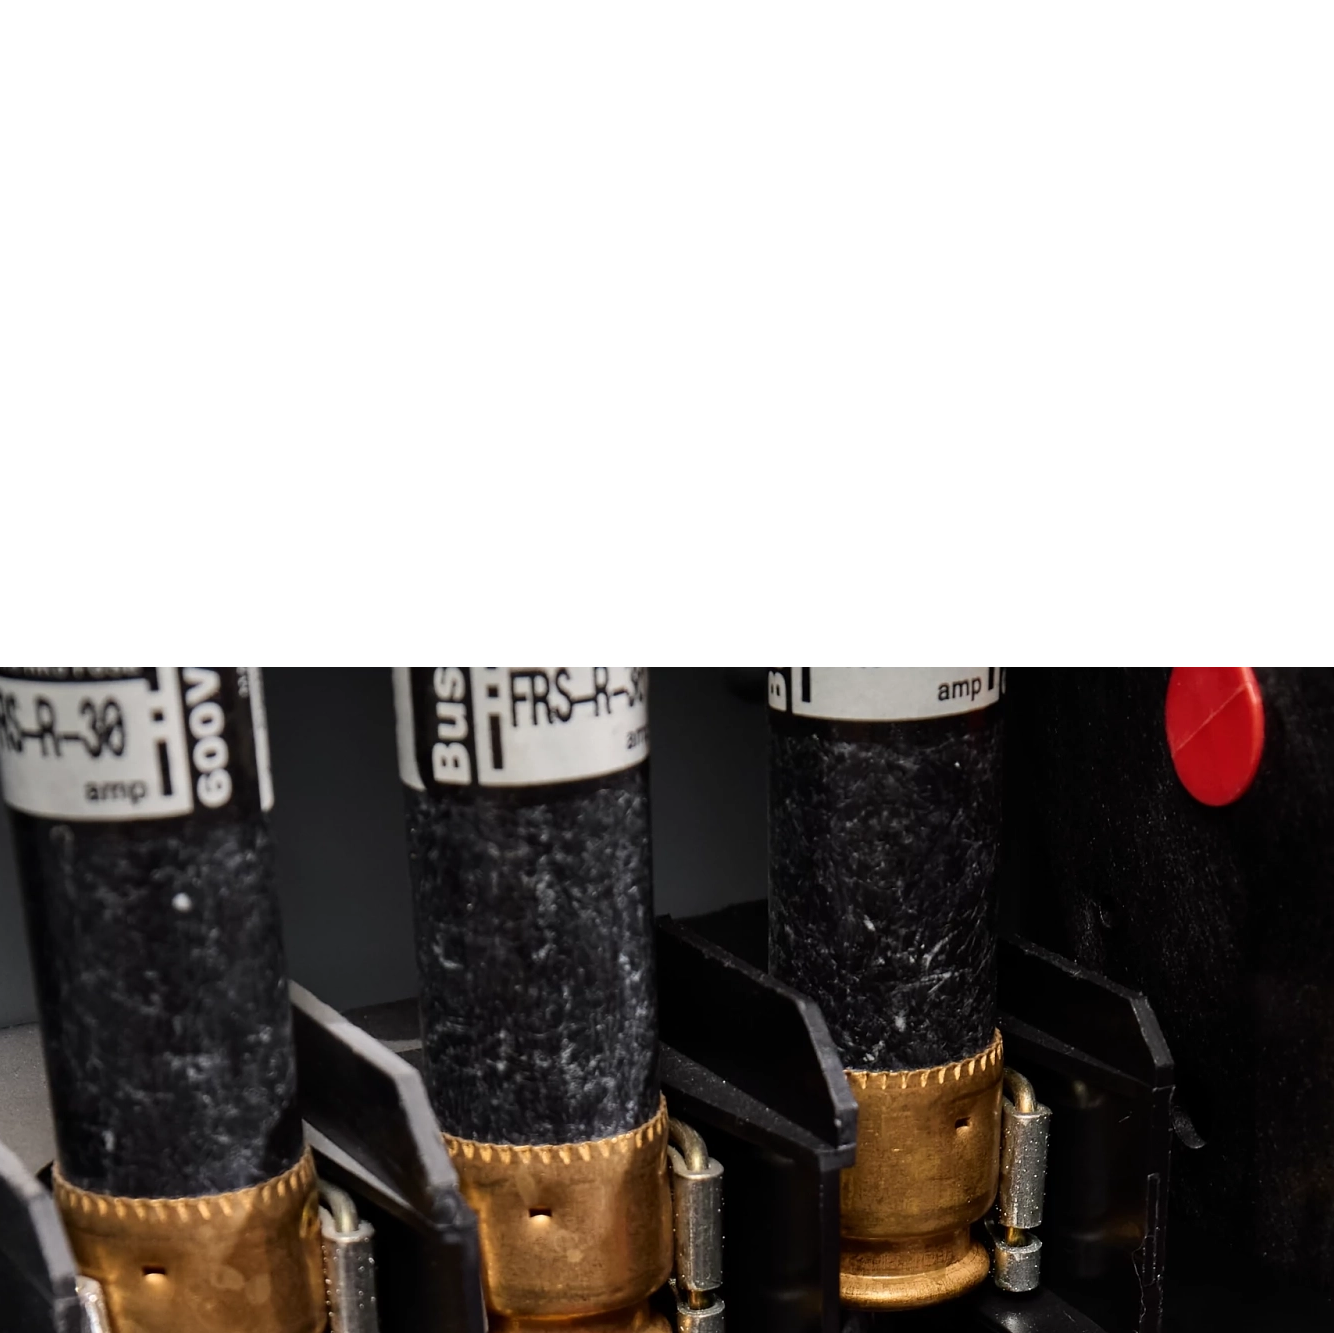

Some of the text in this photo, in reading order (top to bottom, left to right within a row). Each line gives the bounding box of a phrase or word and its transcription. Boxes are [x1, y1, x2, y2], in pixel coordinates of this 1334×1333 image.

[938, 677, 983, 702] amp
[183, 666, 233, 808] 600V
[84, 779, 147, 806] amp
